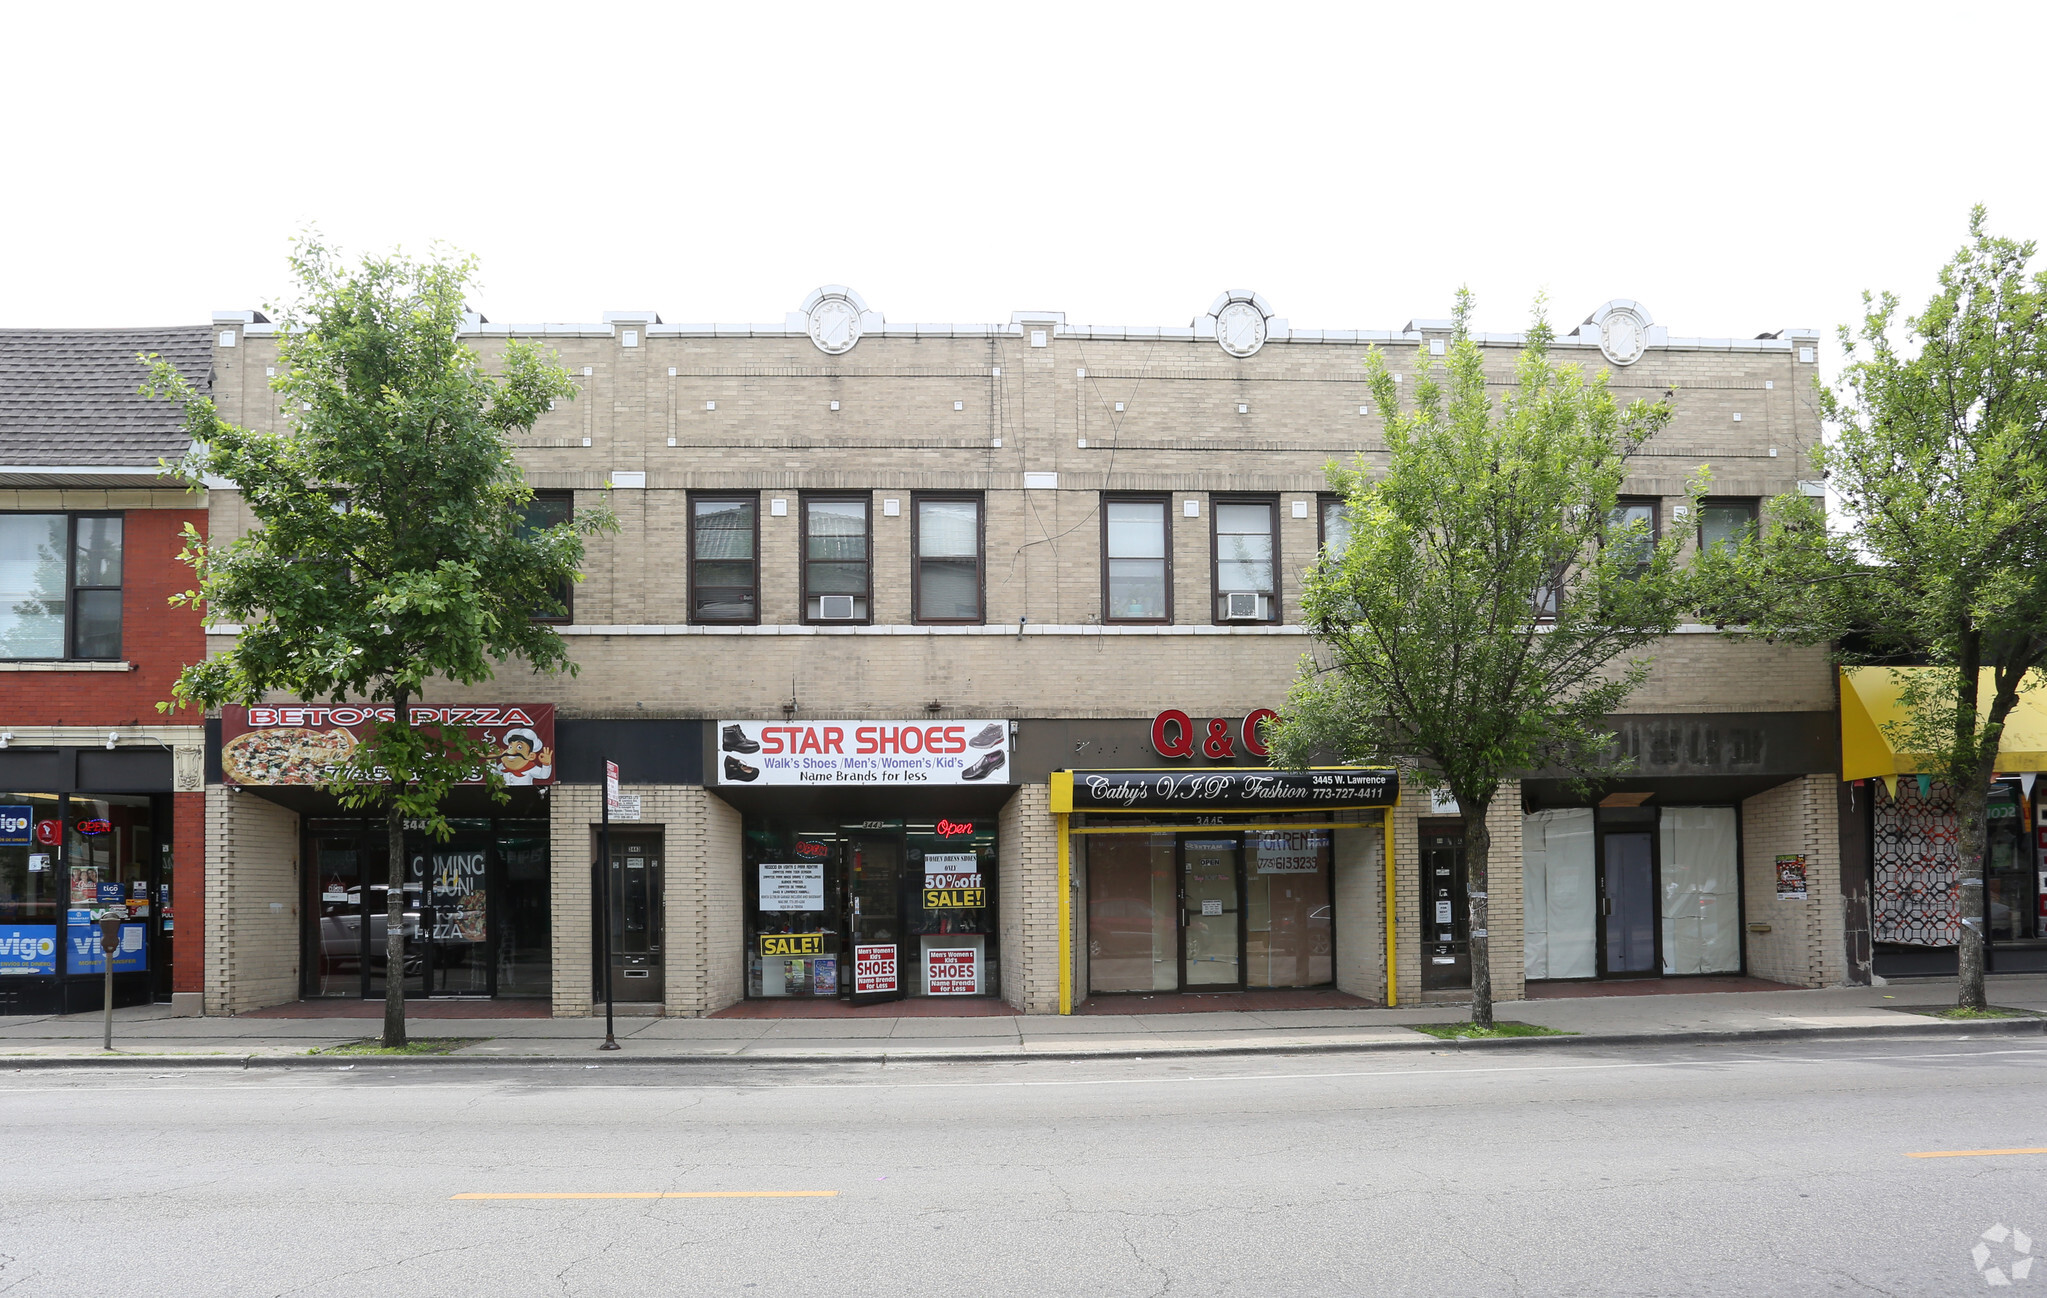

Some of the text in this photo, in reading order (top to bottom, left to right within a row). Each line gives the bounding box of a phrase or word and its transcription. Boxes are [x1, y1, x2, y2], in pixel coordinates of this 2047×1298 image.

[248, 707, 535, 726] BETO'S PIZZA
[761, 726, 967, 754] STAR SHOES
[1150, 708, 1195, 759] Q
[1202, 717, 1236, 759] &
[764, 757, 800, 769] Walk's
[803, 757, 837, 769] Shoes
[800, 770, 928, 781] Name Brands for less
[1312, 775, 1386, 785] 3445 W. Lawrence
[1085, 774, 1309, 807] Cathy's V.I.P. Fashion
[1312, 788, 1383, 799] 773-727-4411
[77, 821, 112, 832] OPEN
[403, 820, 430, 830] 344
[1196, 816, 1224, 825] 3445
[937, 819, 974, 839] Open
[795, 841, 828, 856] OPEN
[1257, 832, 1280, 851] FOR
[1282, 832, 1318, 851] RENT
[432, 877, 474, 897] OON!
[924, 874, 982, 889] 50%off
[926, 890, 982, 907] SALE!
[414, 924, 464, 940] PZZA
[764, 937, 820, 955] SALE!
[857, 961, 895, 976] SHOES
[929, 964, 974, 978] SHOES
